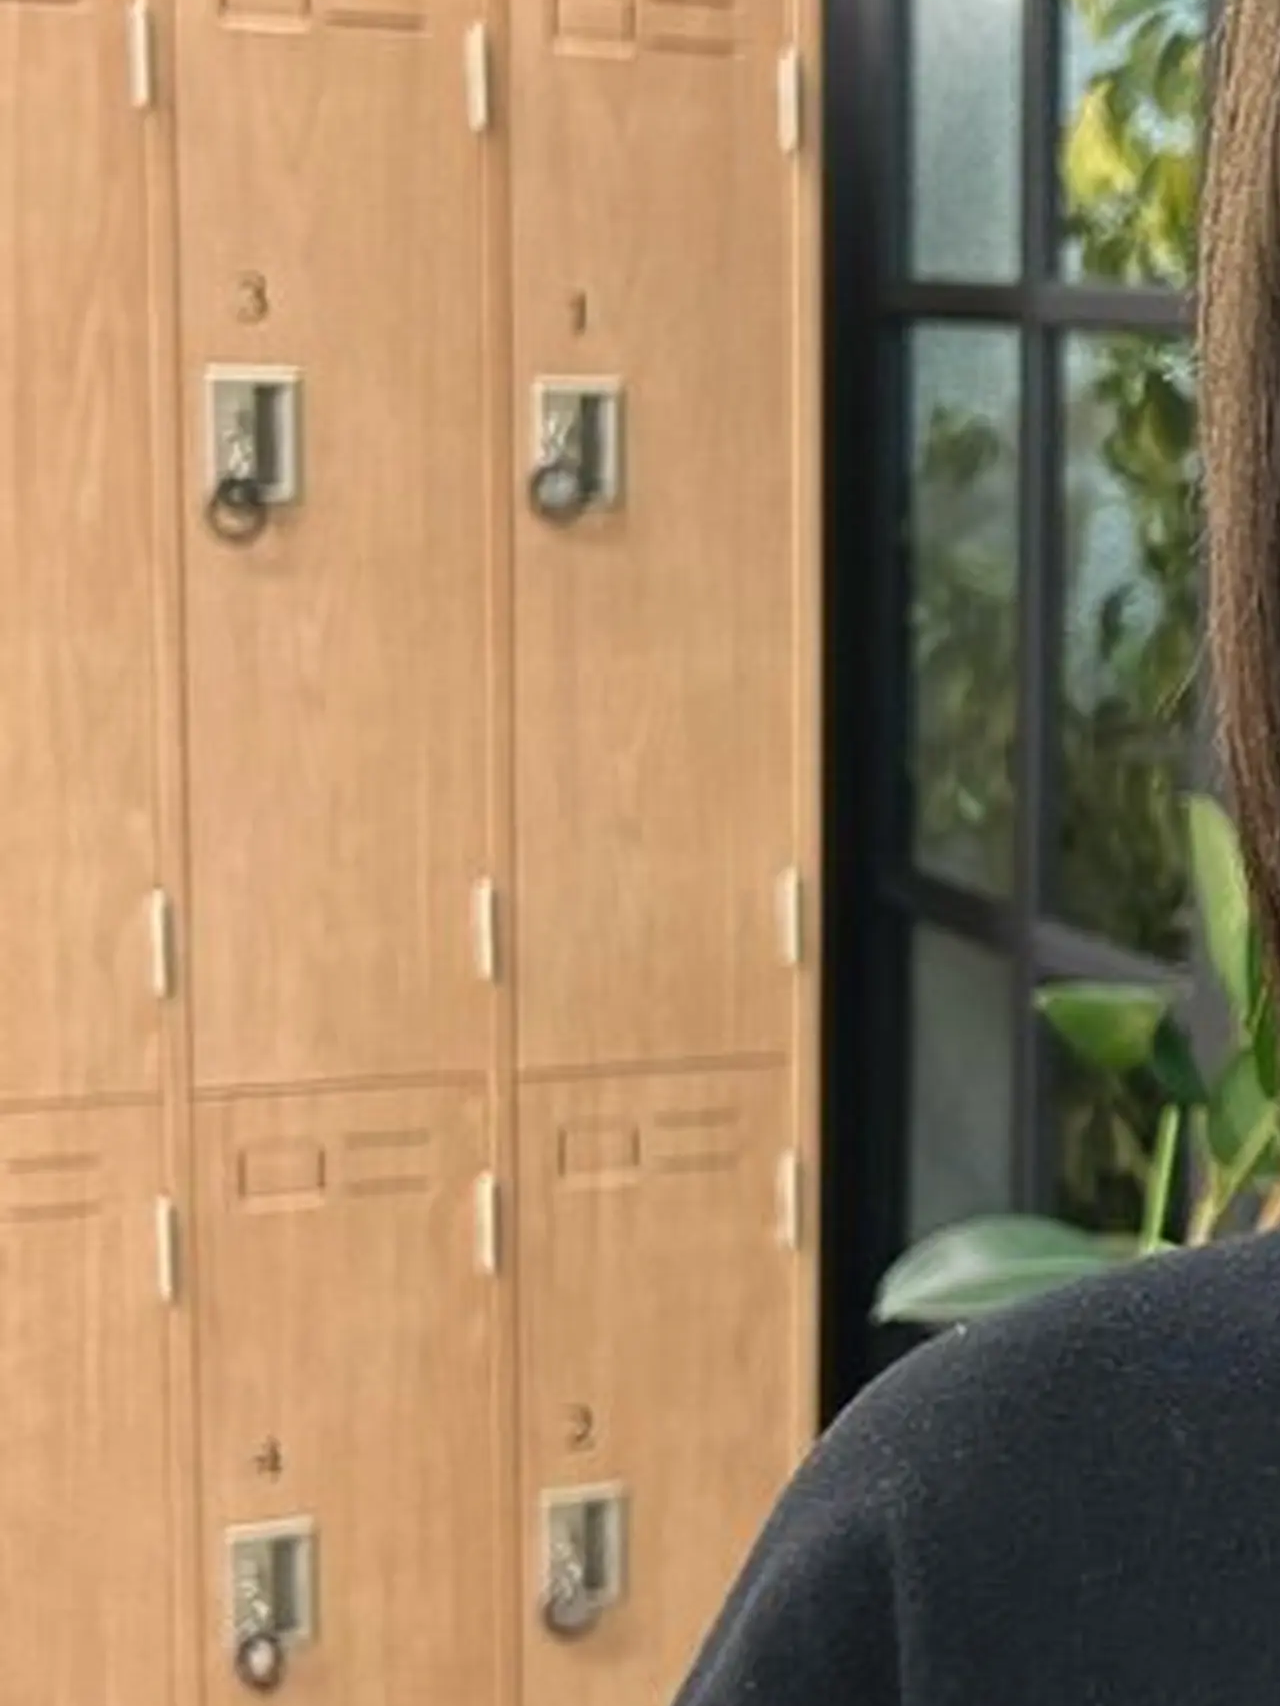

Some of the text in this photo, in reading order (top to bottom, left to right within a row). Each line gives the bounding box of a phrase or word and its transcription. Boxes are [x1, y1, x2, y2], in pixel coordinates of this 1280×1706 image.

[236, 270, 269, 326] 3
[567, 289, 587, 338] 1
[564, 1401, 597, 1453] 2
[254, 1433, 283, 1485] 4
